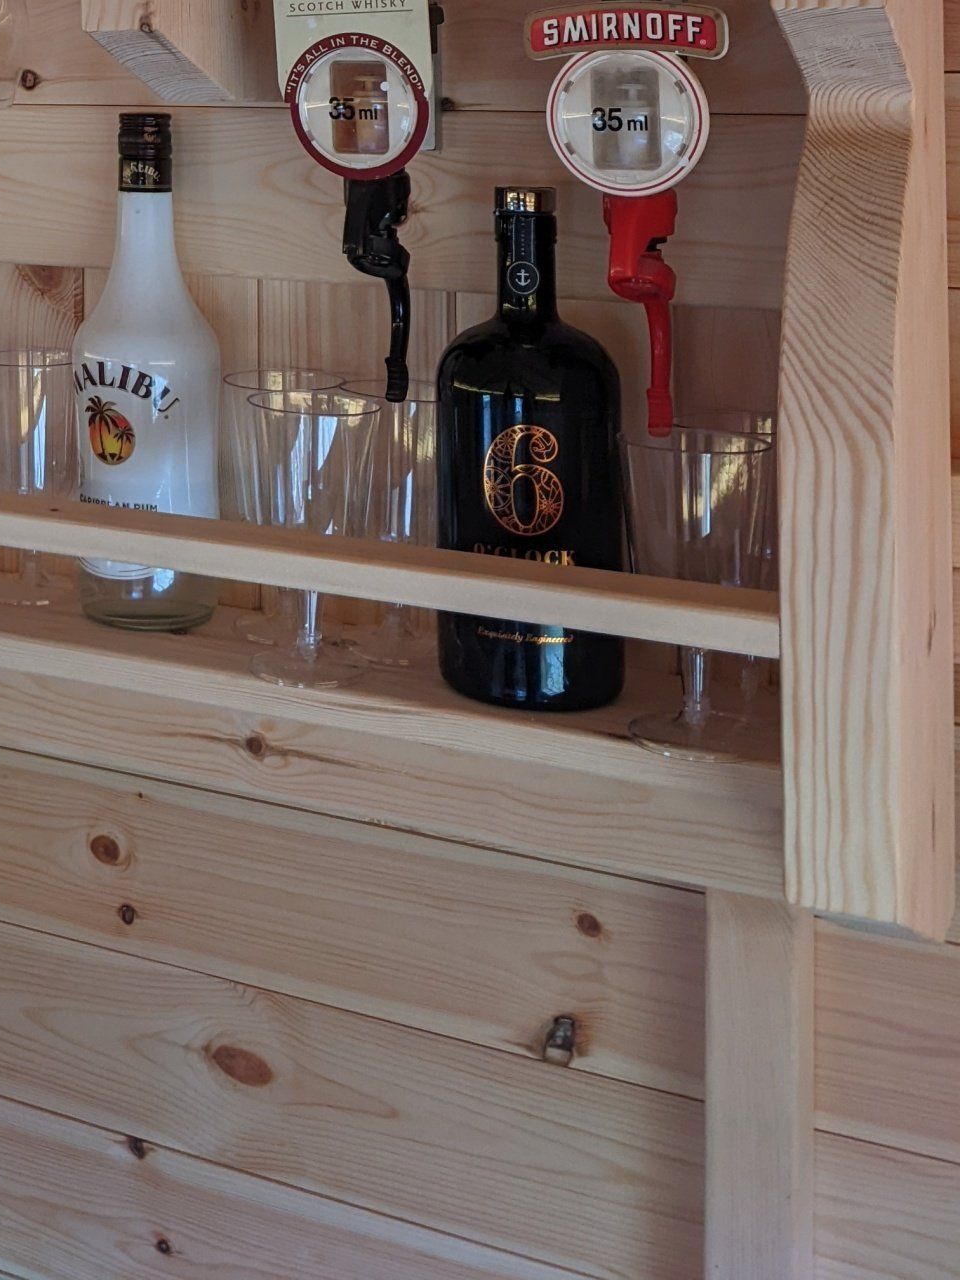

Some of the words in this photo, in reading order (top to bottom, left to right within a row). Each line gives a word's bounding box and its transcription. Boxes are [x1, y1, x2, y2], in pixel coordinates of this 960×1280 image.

[289, 0, 344, 13] SCOTCH
[542, 12, 702, 46] SMIRNOFF
[305, 44, 328, 63] ALL
[331, 37, 345, 48] IN
[350, 35, 379, 49] THE
[329, 96, 355, 120] 35
[359, 105, 378, 120] ml
[592, 107, 623, 132] 35
[627, 115, 648, 131] ml
[483, 424, 565, 536] 6
